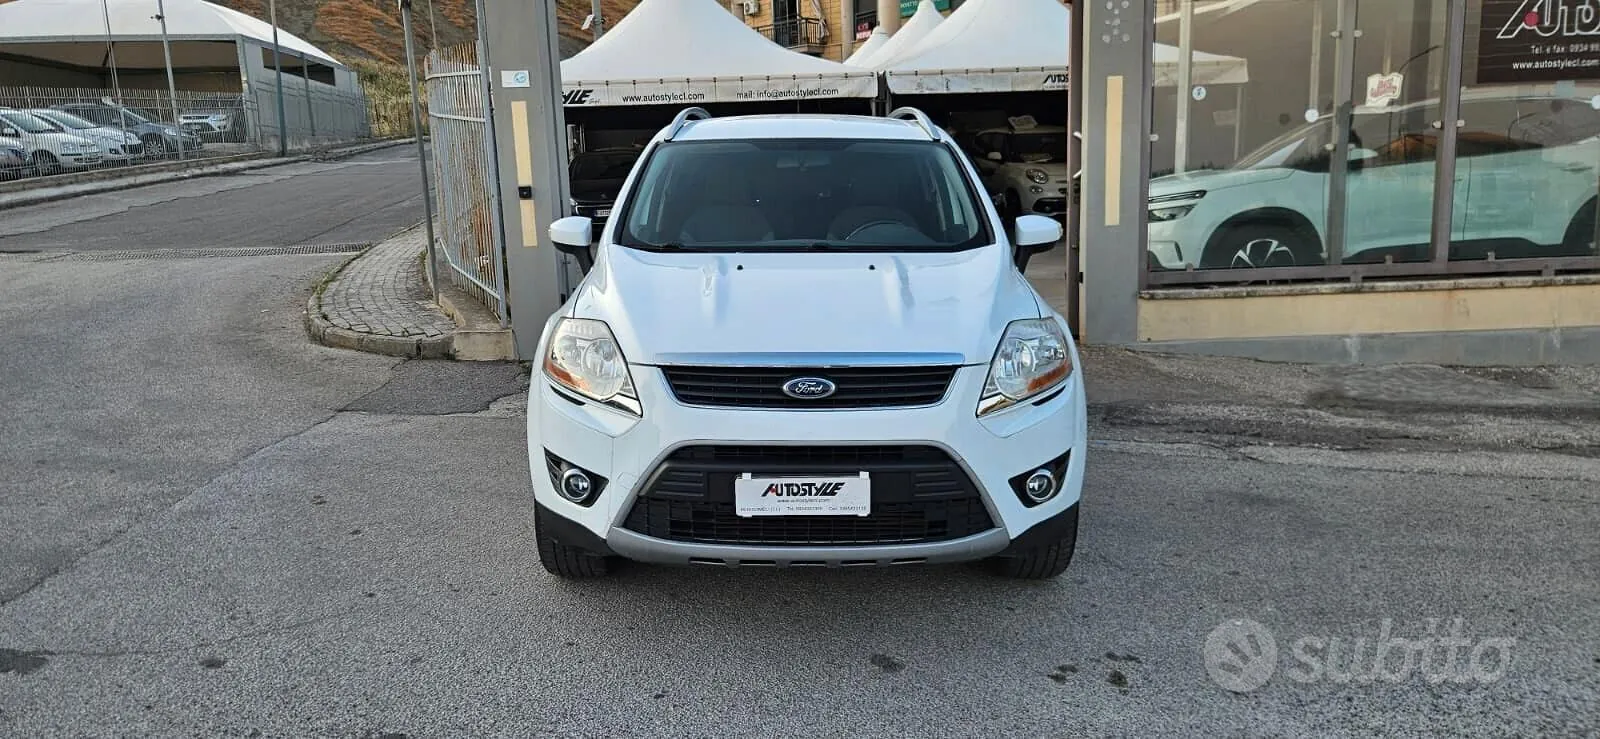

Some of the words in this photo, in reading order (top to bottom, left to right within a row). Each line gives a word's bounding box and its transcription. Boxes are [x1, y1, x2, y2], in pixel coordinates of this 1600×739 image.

[1496, 0, 1600, 39] AUTO
[622, 92, 705, 103] www.autostylecl.com
[736, 90, 755, 99] mail:
[757, 87, 839, 99] info@autostylecl.com
[795, 382, 823, 394] Ford
[760, 482, 845, 497] AUTOSTYLE
